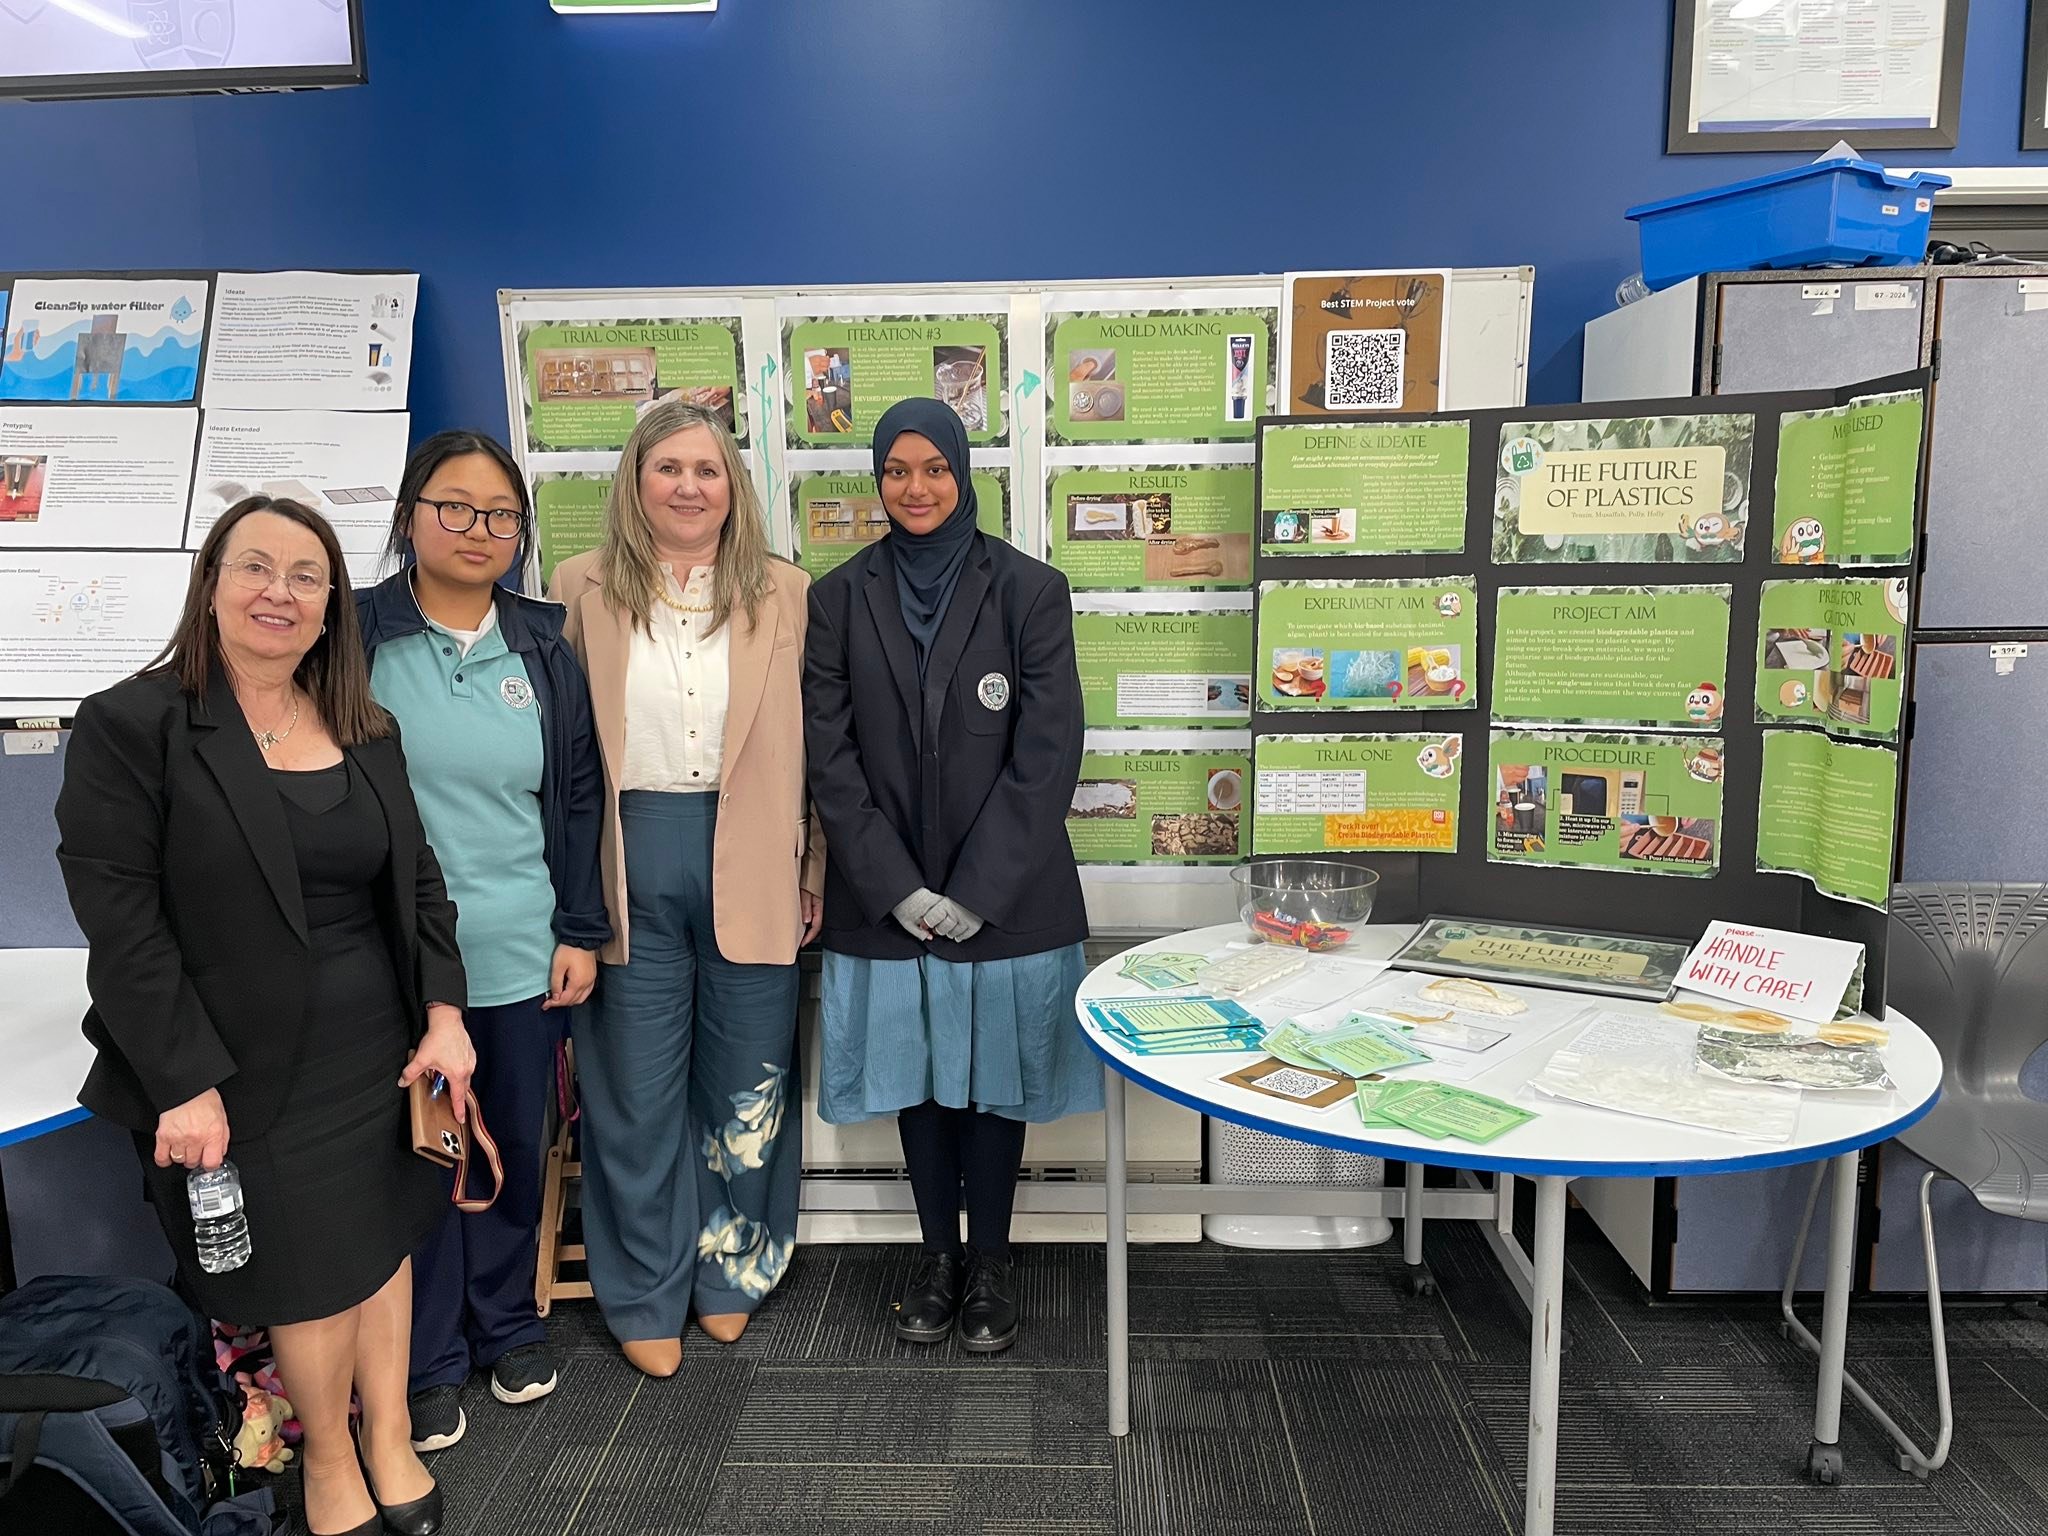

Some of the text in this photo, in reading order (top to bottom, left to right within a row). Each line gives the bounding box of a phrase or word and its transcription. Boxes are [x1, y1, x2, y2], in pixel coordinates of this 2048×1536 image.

[34, 301, 88, 312] CleanSip
[91, 302, 126, 310] water
[1321, 300, 1338, 308] Best
[1340, 300, 1363, 308] STEM
[1366, 299, 1394, 309] Project
[561, 328, 698, 344] TRIAL ONE RESULTS
[847, 328, 942, 341] ITERATION #3
[1100, 323, 1222, 338] MOULD MAKING
[1852, 415, 1883, 432] USED
[1304, 435, 1427, 449] DEFINE & IDEATE
[1546, 460, 1697, 483] THE FUTURE
[827, 481, 869, 494] TRIAL
[1129, 476, 1188, 489] RESULTS
[1547, 486, 1694, 507] OF PLASTICS
[1304, 597, 1424, 610] EXPERIMENT AIM
[1841, 591, 1862, 606] FOR
[1553, 607, 1656, 622] PROJECT AIM
[1115, 621, 1200, 633] NEW RECIPE
[1386, 621, 1417, 629] substance
[1597, 628, 1648, 636] biodegradable
[1650, 628, 1678, 636] plastics
[1315, 749, 1393, 762] TRIAL ONE
[1544, 747, 1656, 766] PROCEDURE
[1124, 760, 1181, 772] RESULTS
[1476, 938, 1622, 964] THE FUTURE
[1704, 936, 1784, 971] HANDLE
[1470, 949, 1615, 972] OF PLASTICS
[1689, 960, 1813, 1003] WITH CARE!
